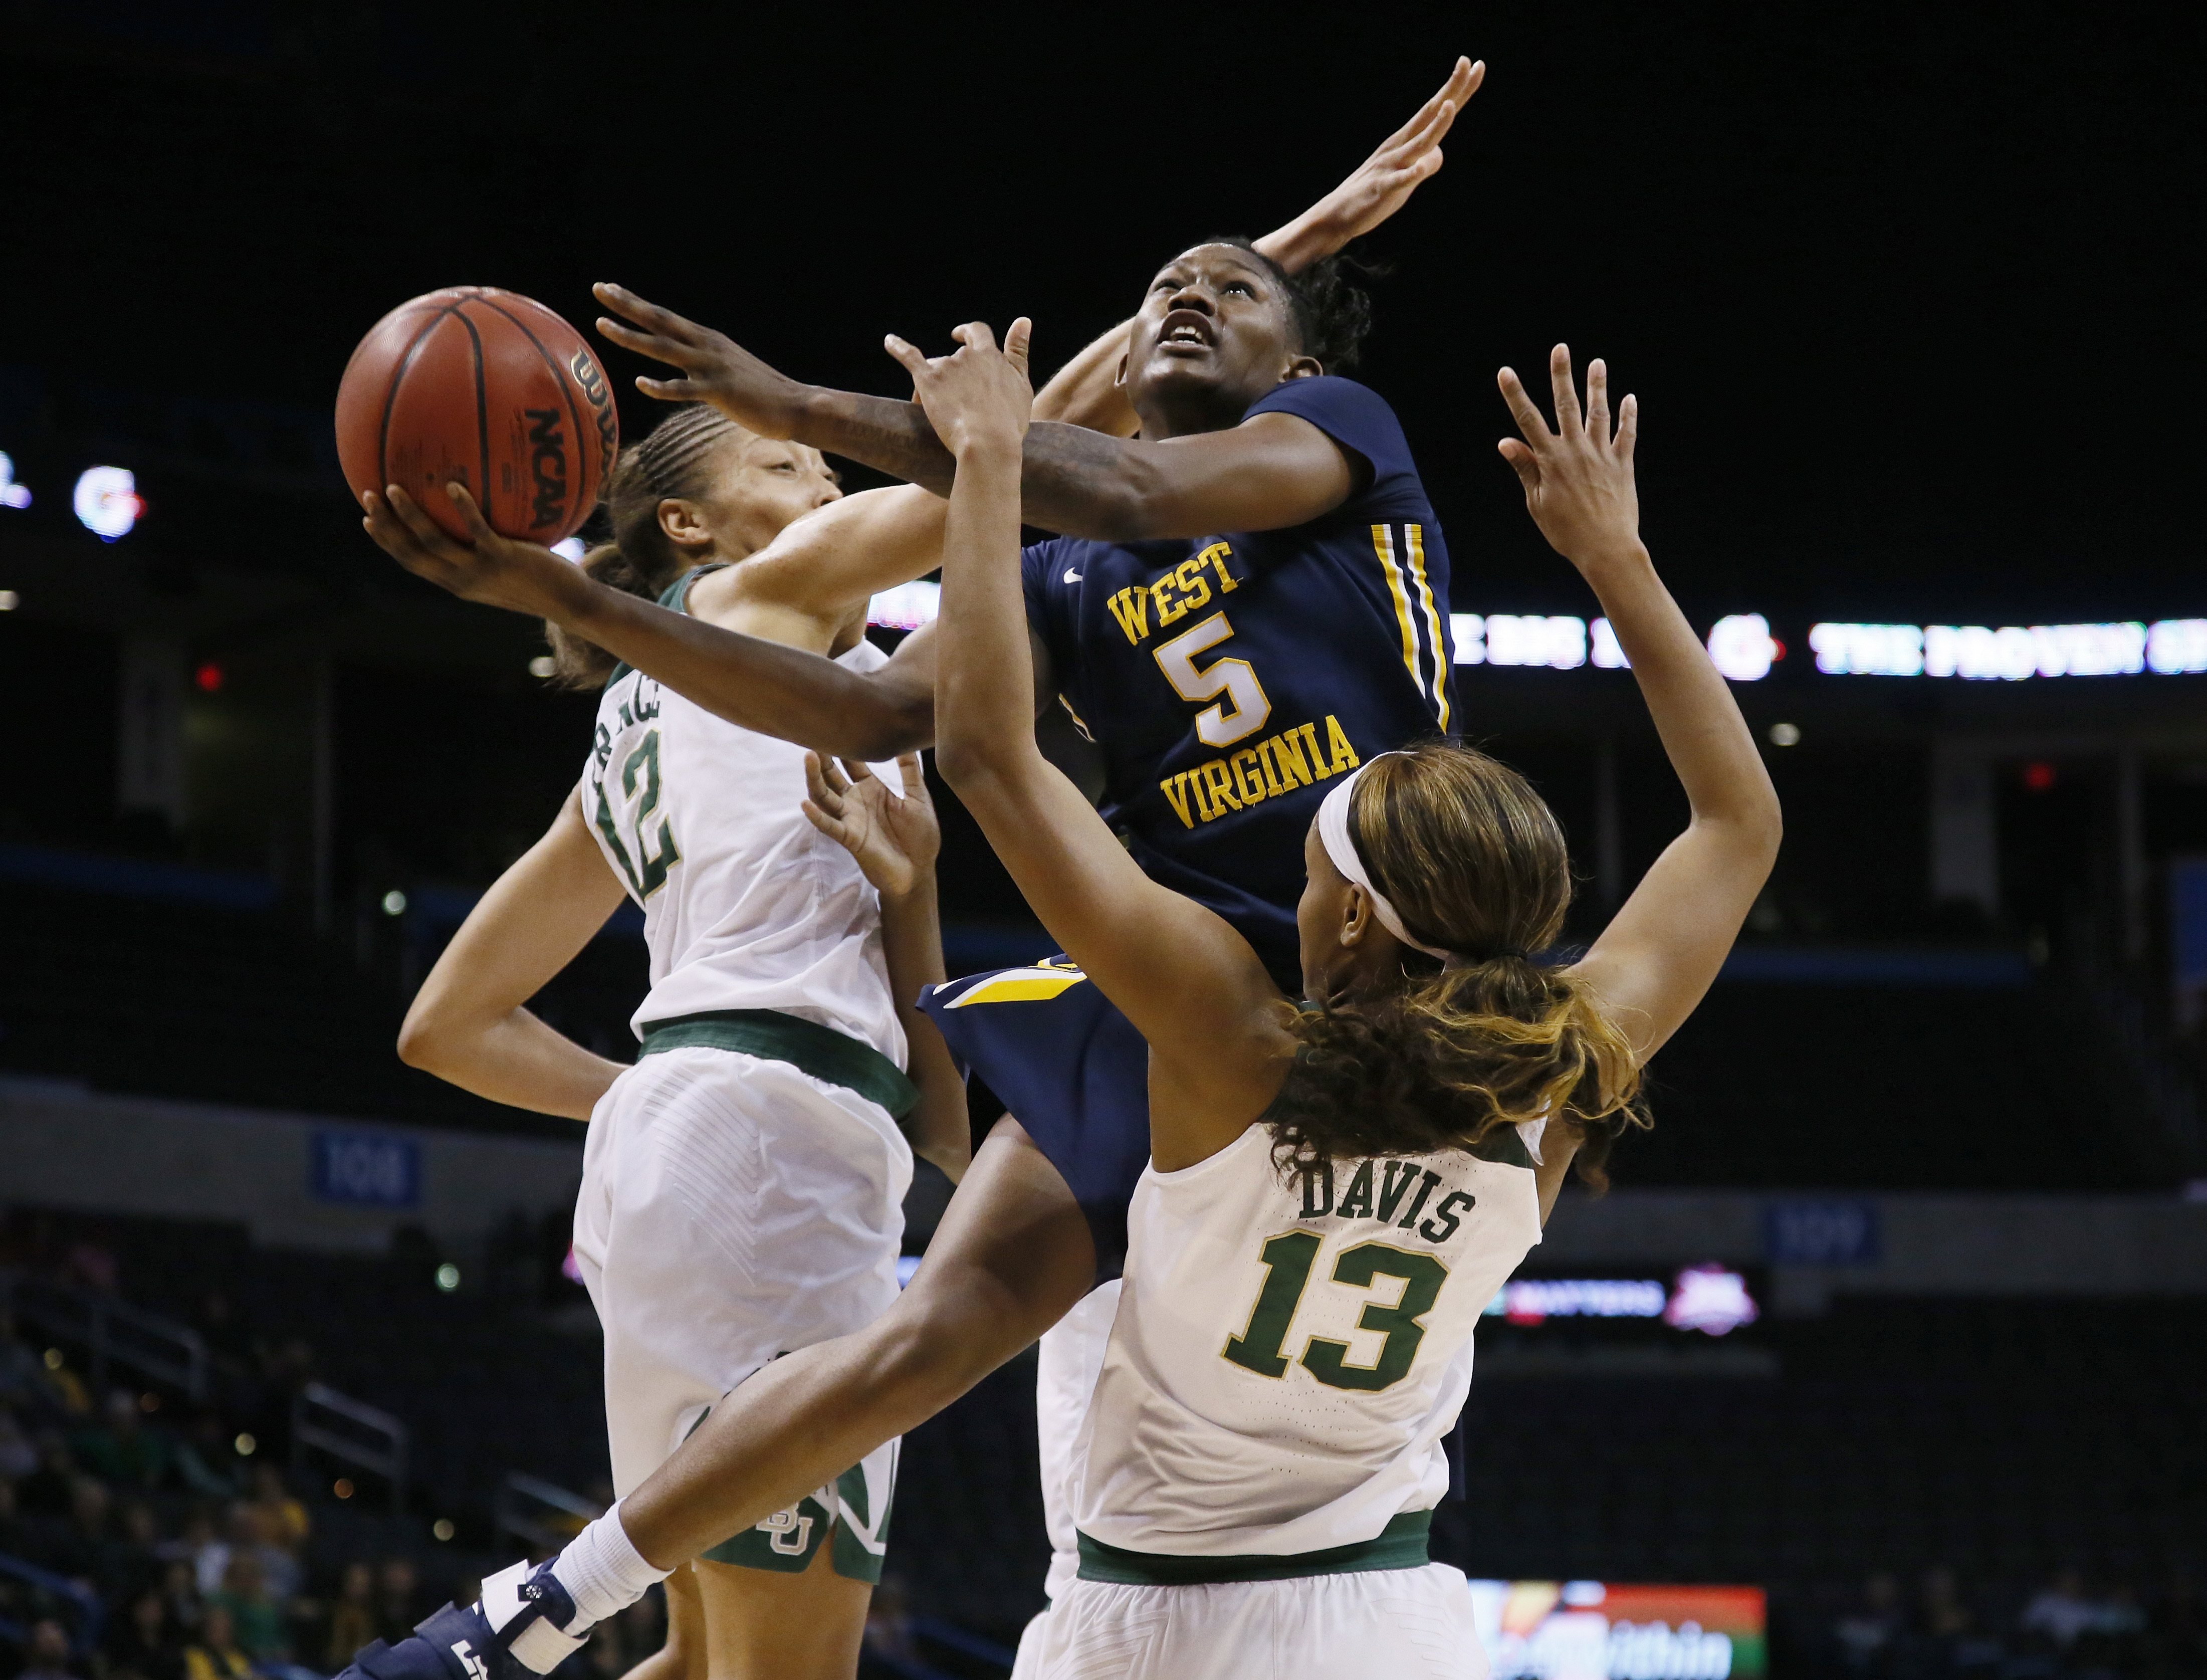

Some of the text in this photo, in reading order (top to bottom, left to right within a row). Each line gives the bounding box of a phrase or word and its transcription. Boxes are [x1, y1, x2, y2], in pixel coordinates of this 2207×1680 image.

[525, 408, 567, 530] NCAA
[1107, 542, 1234, 646] WEST
[1152, 610, 1272, 748] 5
[1160, 715, 1360, 830] VIRGINIA
[1299, 1159, 1476, 1244] DAVIS
[1220, 1227, 1451, 1393] 13
